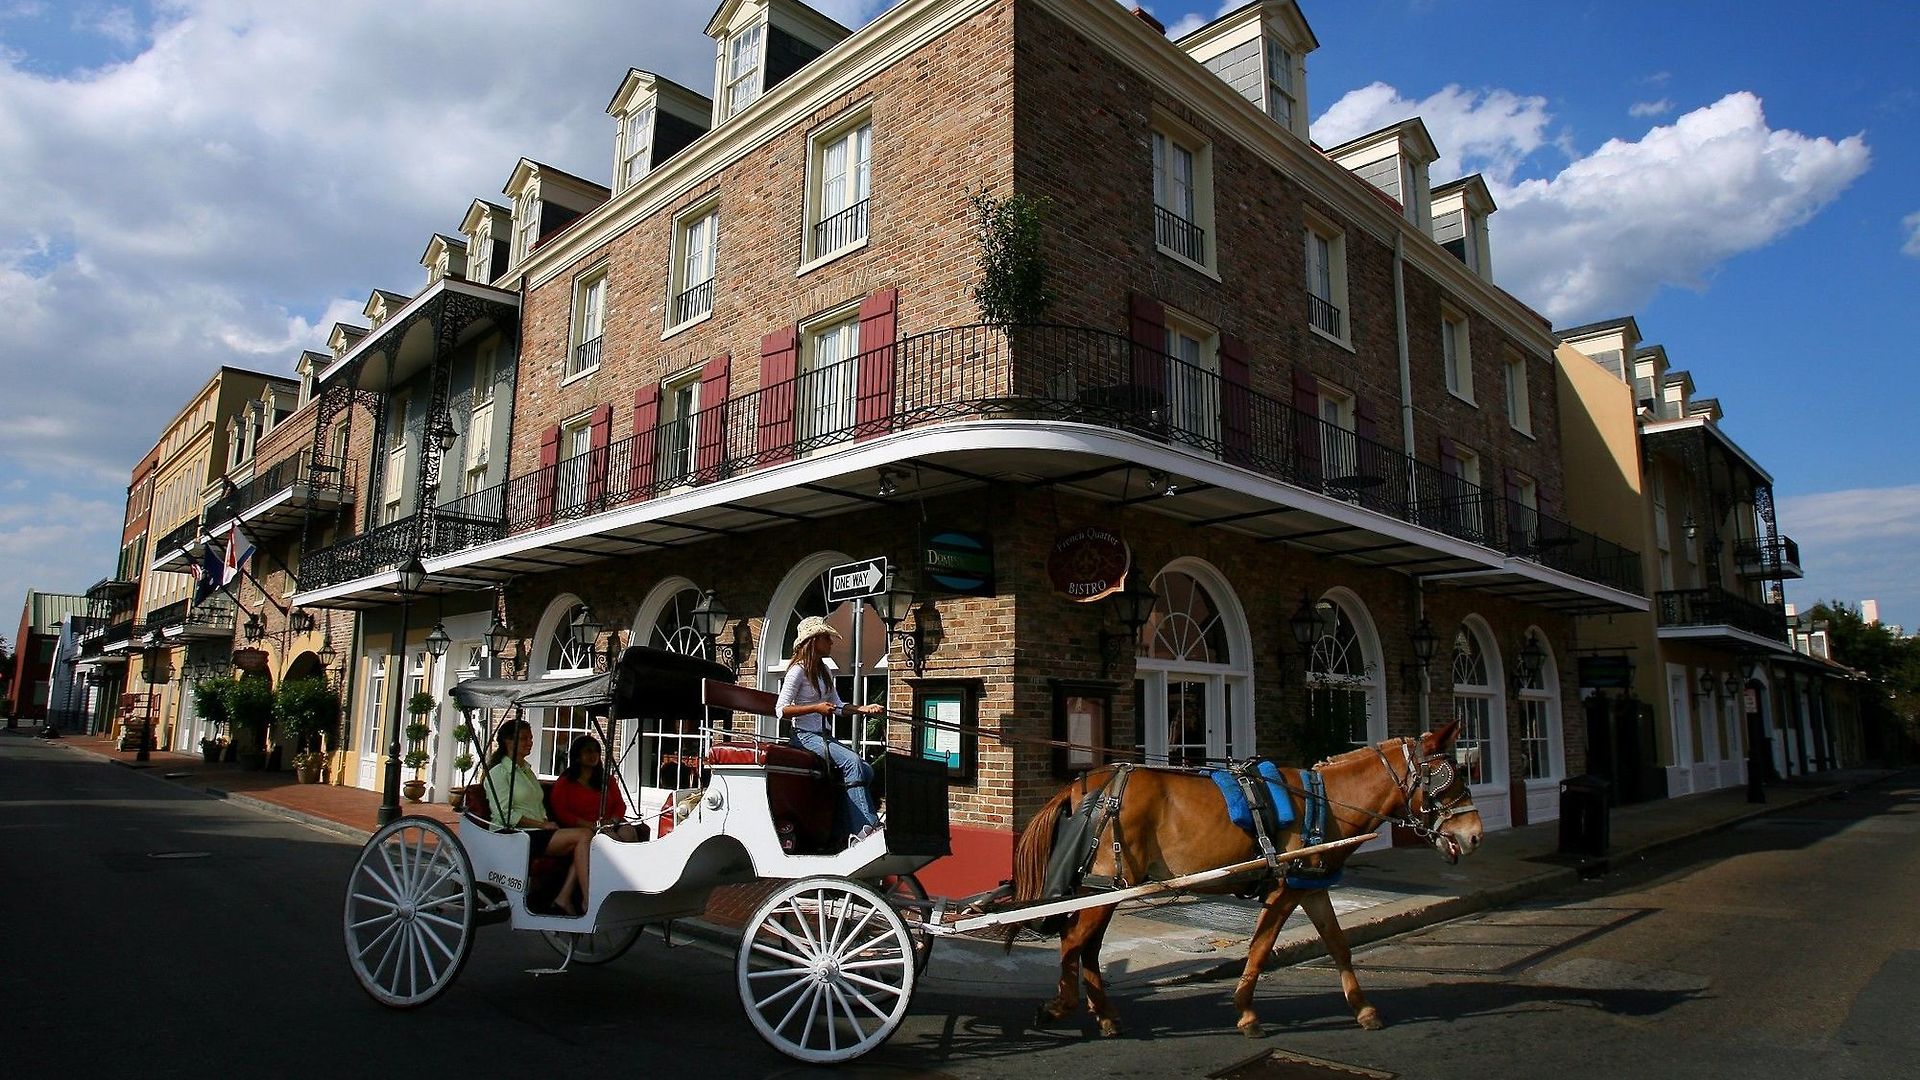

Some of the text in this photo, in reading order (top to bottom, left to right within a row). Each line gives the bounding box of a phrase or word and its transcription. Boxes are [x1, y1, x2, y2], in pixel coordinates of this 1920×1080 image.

[1087, 527, 1121, 546] Quarter
[835, 571, 869, 590] ONE WAY
[1068, 579, 1107, 595] BISTRO
